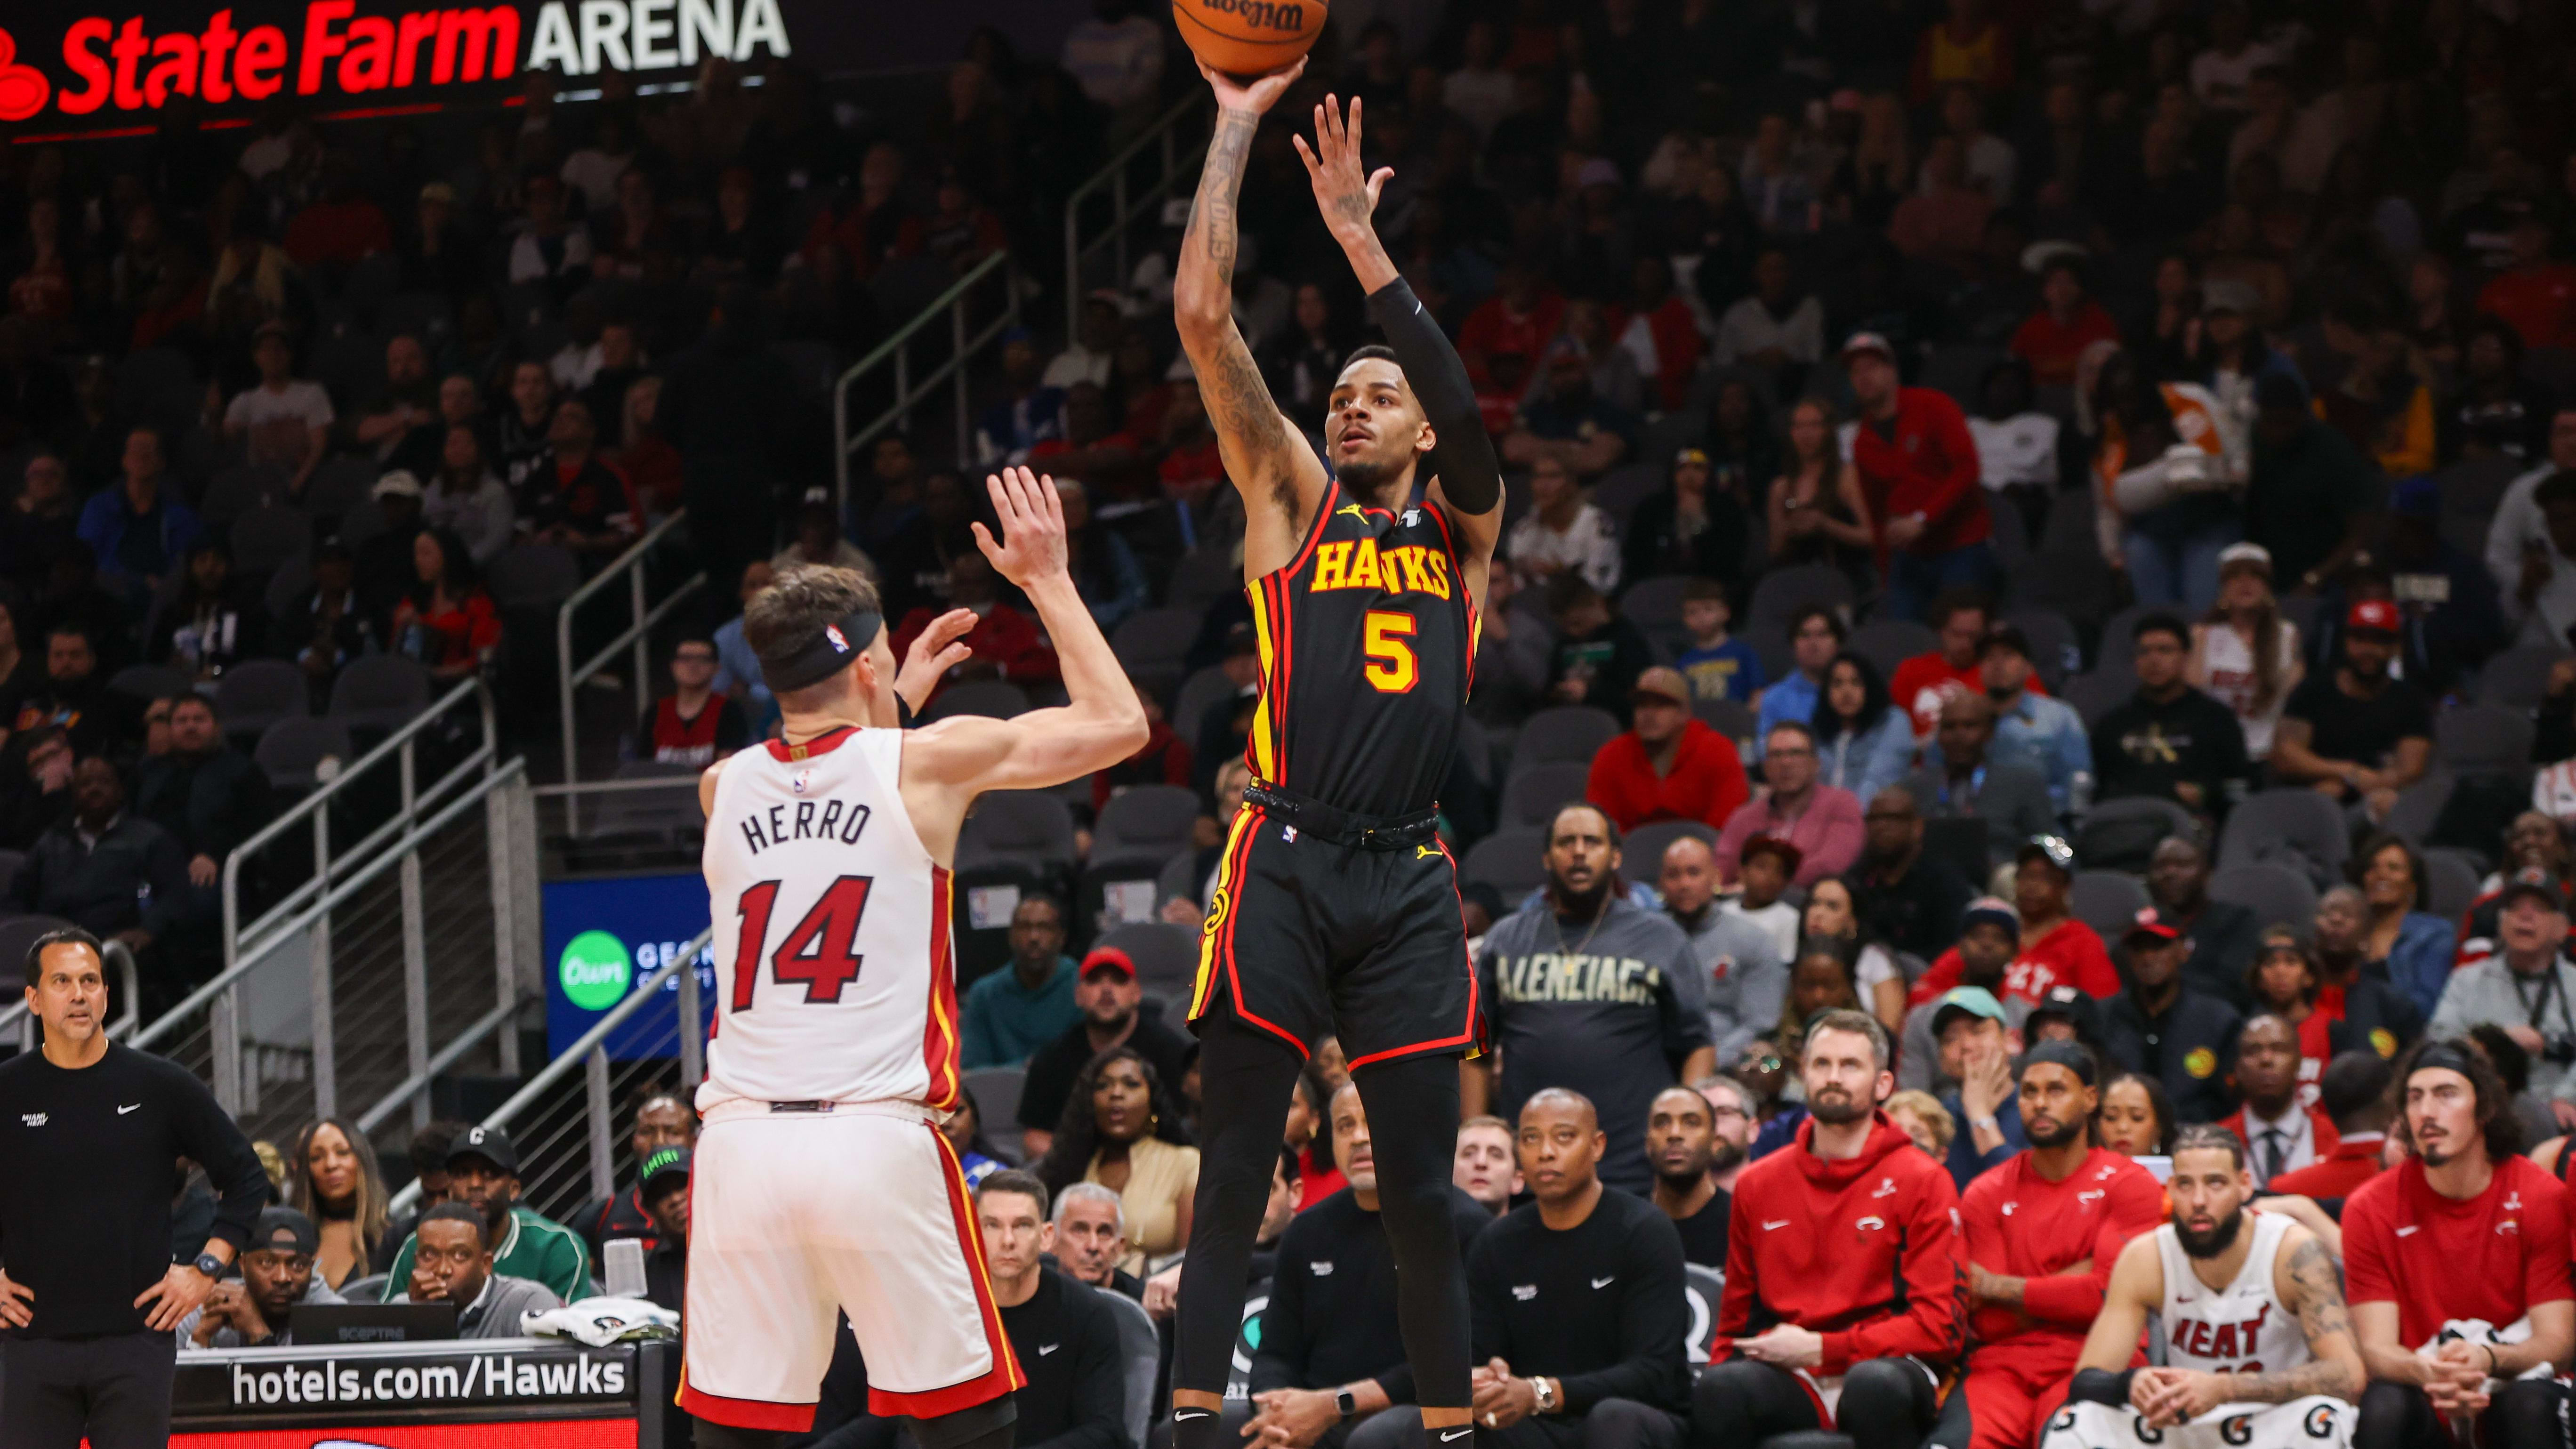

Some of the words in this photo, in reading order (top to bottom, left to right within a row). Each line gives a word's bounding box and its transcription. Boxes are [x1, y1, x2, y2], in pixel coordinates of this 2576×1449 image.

[57, 8, 288, 115] State
[297, 0, 521, 95] Farm
[526, 0, 791, 76] ARENA
[1363, 609, 1420, 693] 5
[740, 799, 871, 855] HERRO
[731, 874, 875, 1014] 14
[565, 956, 624, 986] Own
[22, 1112, 46, 1121] MIAMI
[27, 1115, 48, 1127] HEAT
[642, 1149, 679, 1179] AMIRI
[233, 1352, 625, 1404] hotels.com/Hawks
